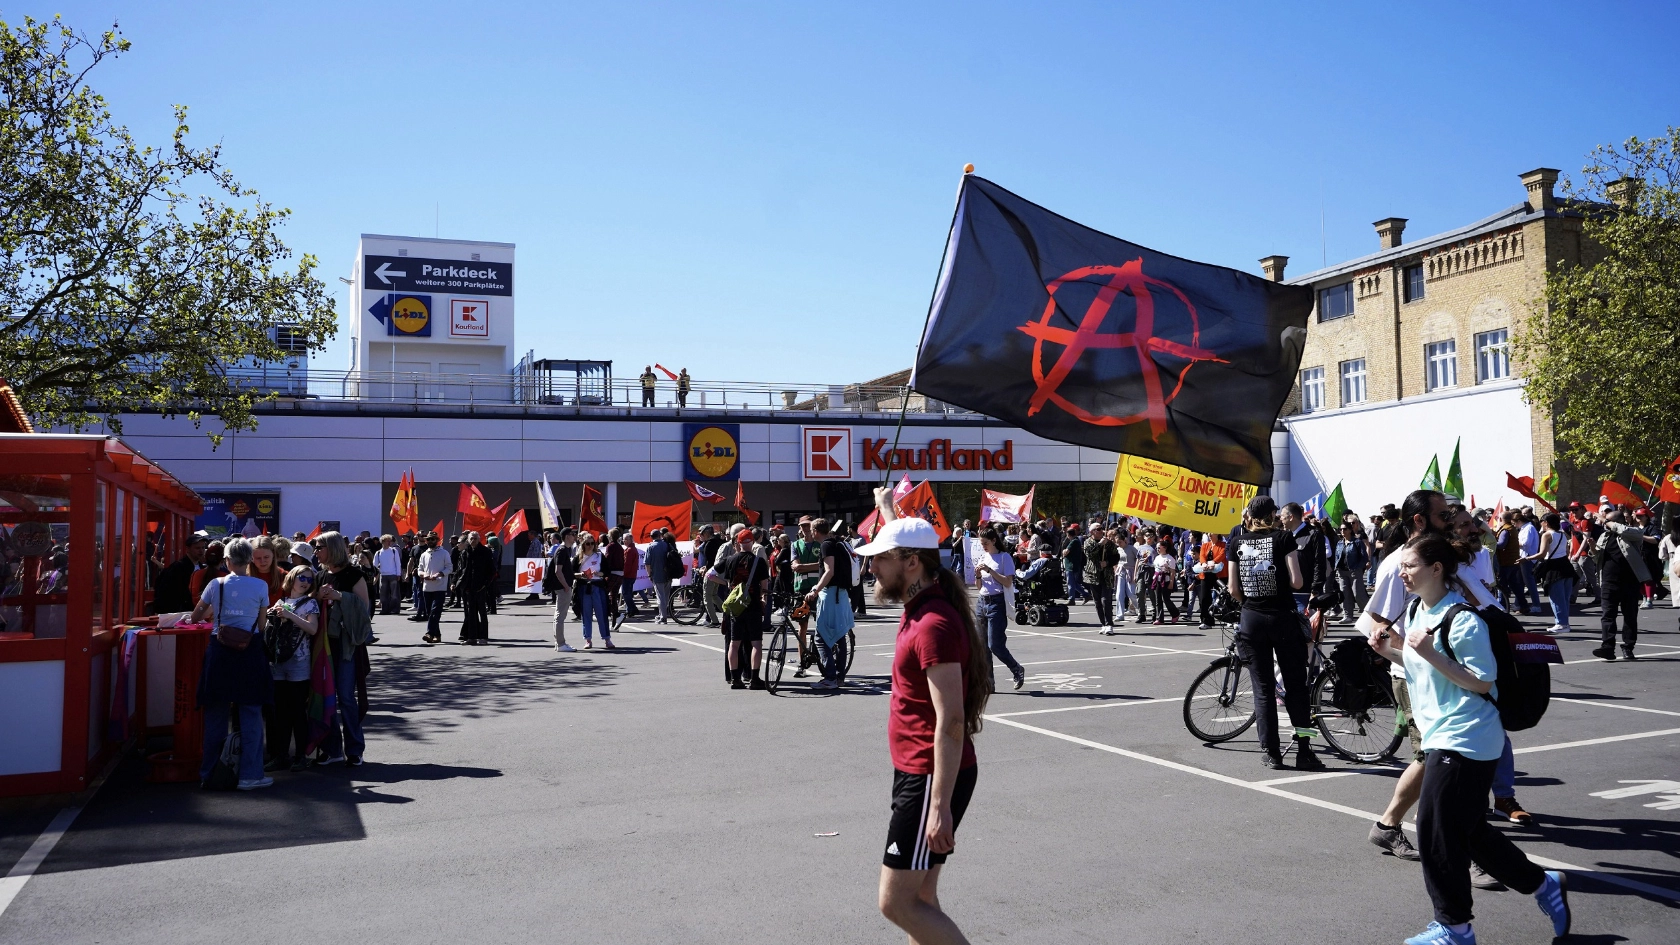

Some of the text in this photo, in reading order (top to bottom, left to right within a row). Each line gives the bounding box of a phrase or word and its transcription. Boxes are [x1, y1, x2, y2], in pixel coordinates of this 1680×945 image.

[422, 264, 497, 280] Parkdeck
[463, 281, 505, 290] Parkplätze
[455, 323, 484, 331] Kaufland
[863, 437, 1014, 471] Kaufland
[1178, 475, 1216, 497] LONG
[1217, 482, 1245, 499] LIVE
[1126, 488, 1169, 516] DIDF
